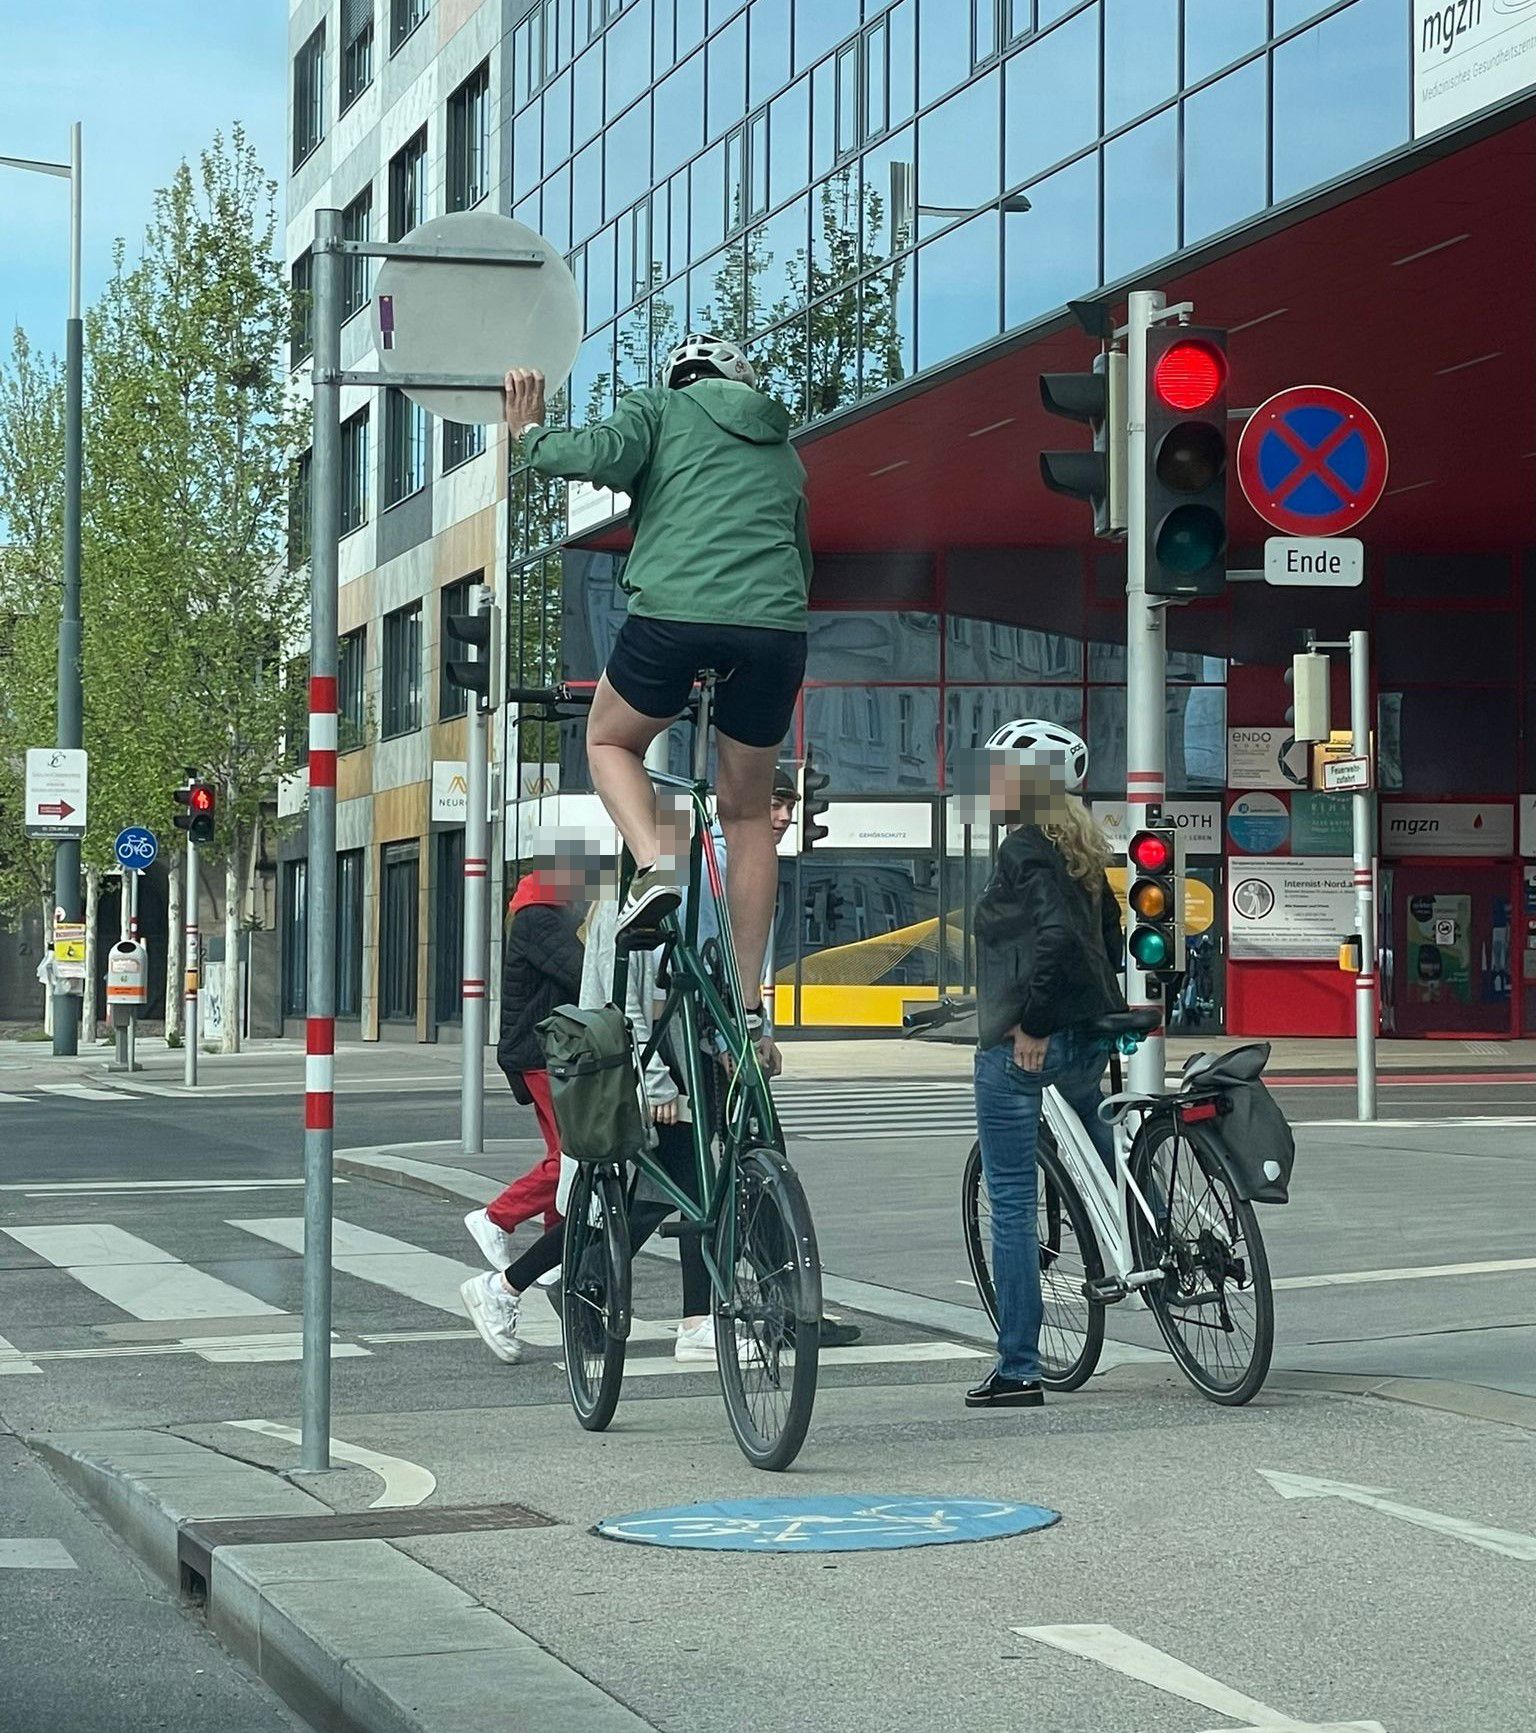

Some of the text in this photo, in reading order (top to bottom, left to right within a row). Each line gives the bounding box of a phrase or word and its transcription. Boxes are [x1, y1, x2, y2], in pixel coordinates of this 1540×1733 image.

[1422, 0, 1481, 54] mgzn
[1287, 549, 1341, 573] Ende
[1390, 818, 1440, 835] mgzn
[1284, 880, 1354, 889] Internist-Nord.a
